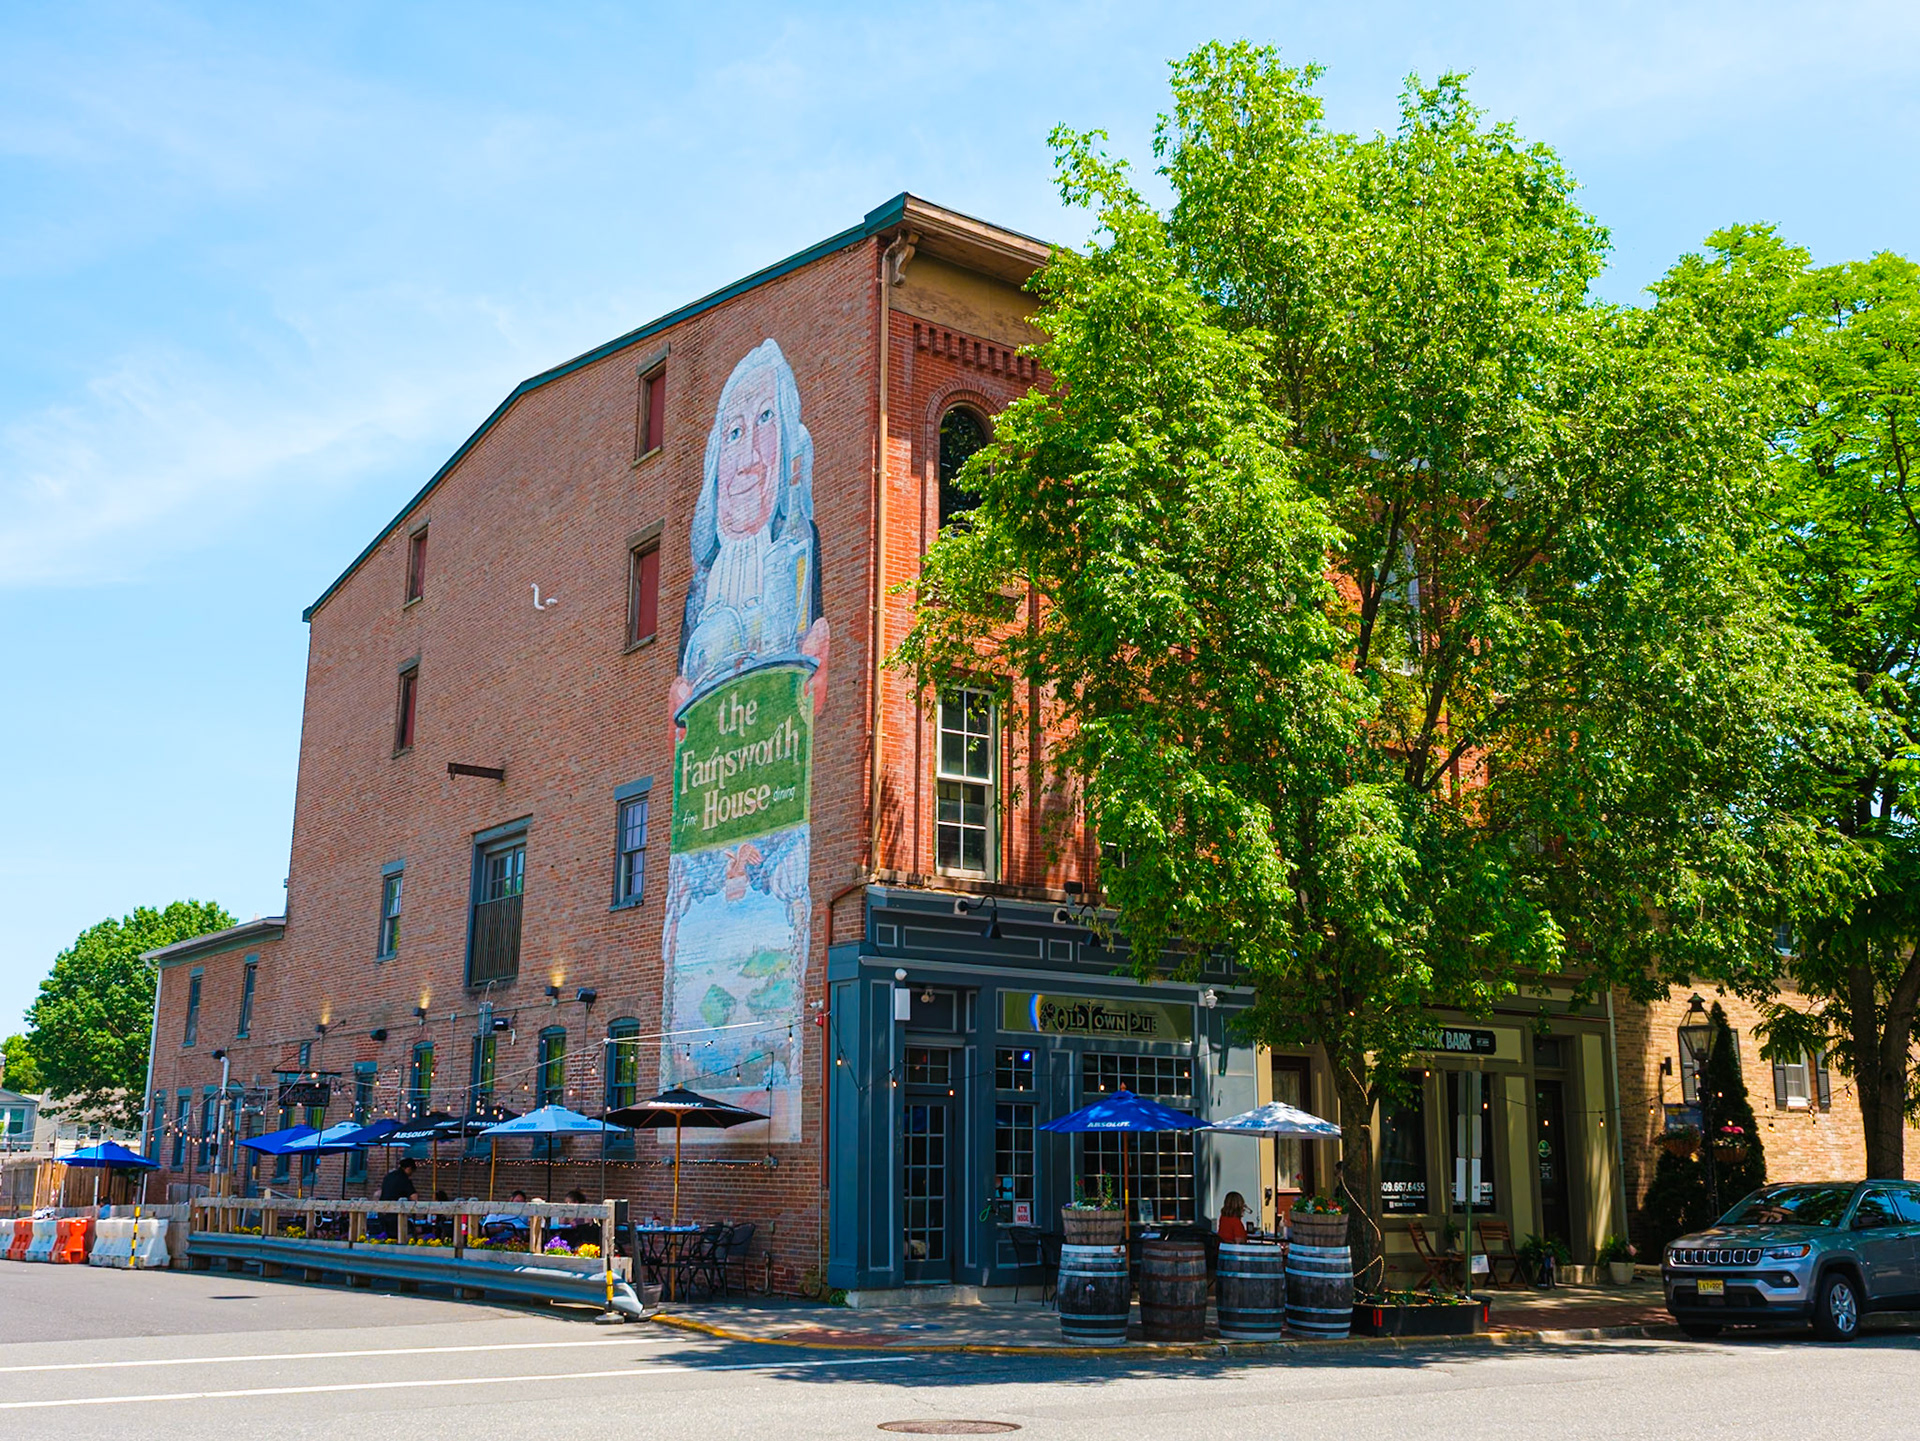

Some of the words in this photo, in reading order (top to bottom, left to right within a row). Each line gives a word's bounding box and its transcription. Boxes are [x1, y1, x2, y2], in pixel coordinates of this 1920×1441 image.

[718, 691, 757, 737] the
[680, 715, 800, 795] Farnsworth
[681, 809, 698, 832] fine
[702, 784, 771, 831] House
[772, 786, 796, 802] dining
[1126, 1010, 1159, 1036] PUB
[1446, 1031, 1472, 1050] BARK
